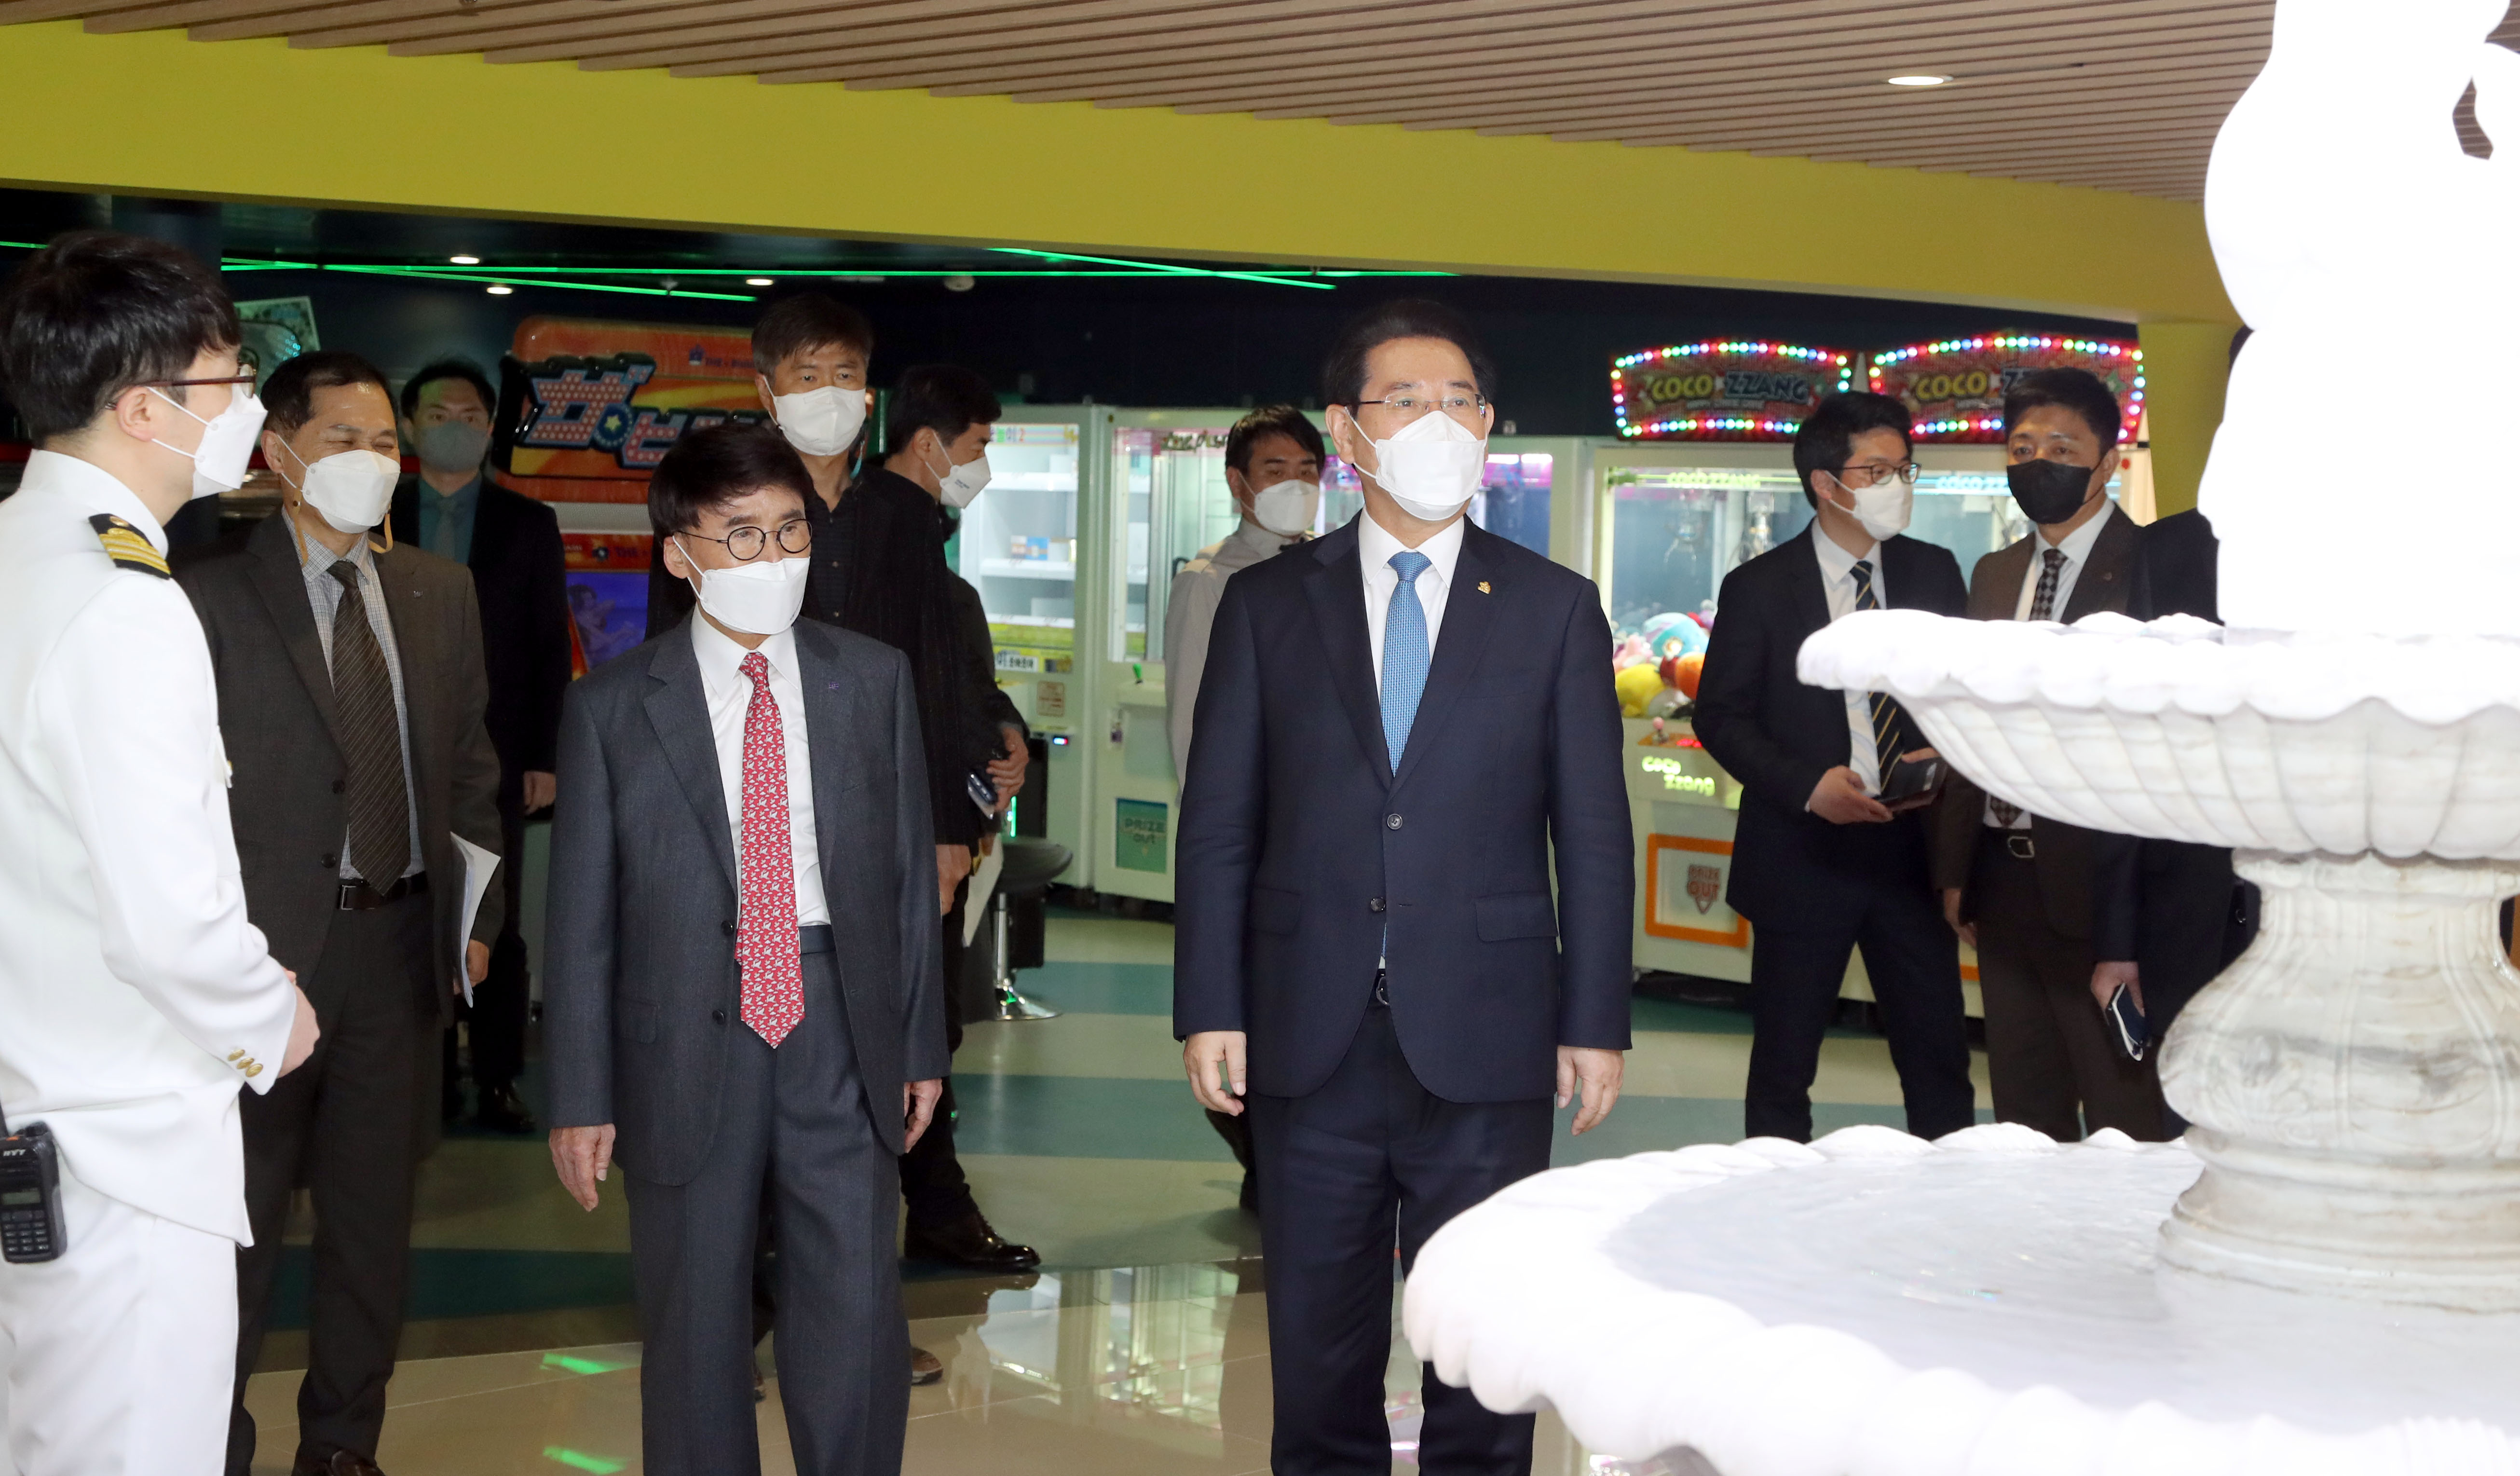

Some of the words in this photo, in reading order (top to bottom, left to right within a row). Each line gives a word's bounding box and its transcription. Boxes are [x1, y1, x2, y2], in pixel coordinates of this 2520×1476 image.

[1651, 373, 1714, 402] COCO
[1723, 370, 1810, 405] ZZANG
[1916, 370, 1988, 399] COCO
